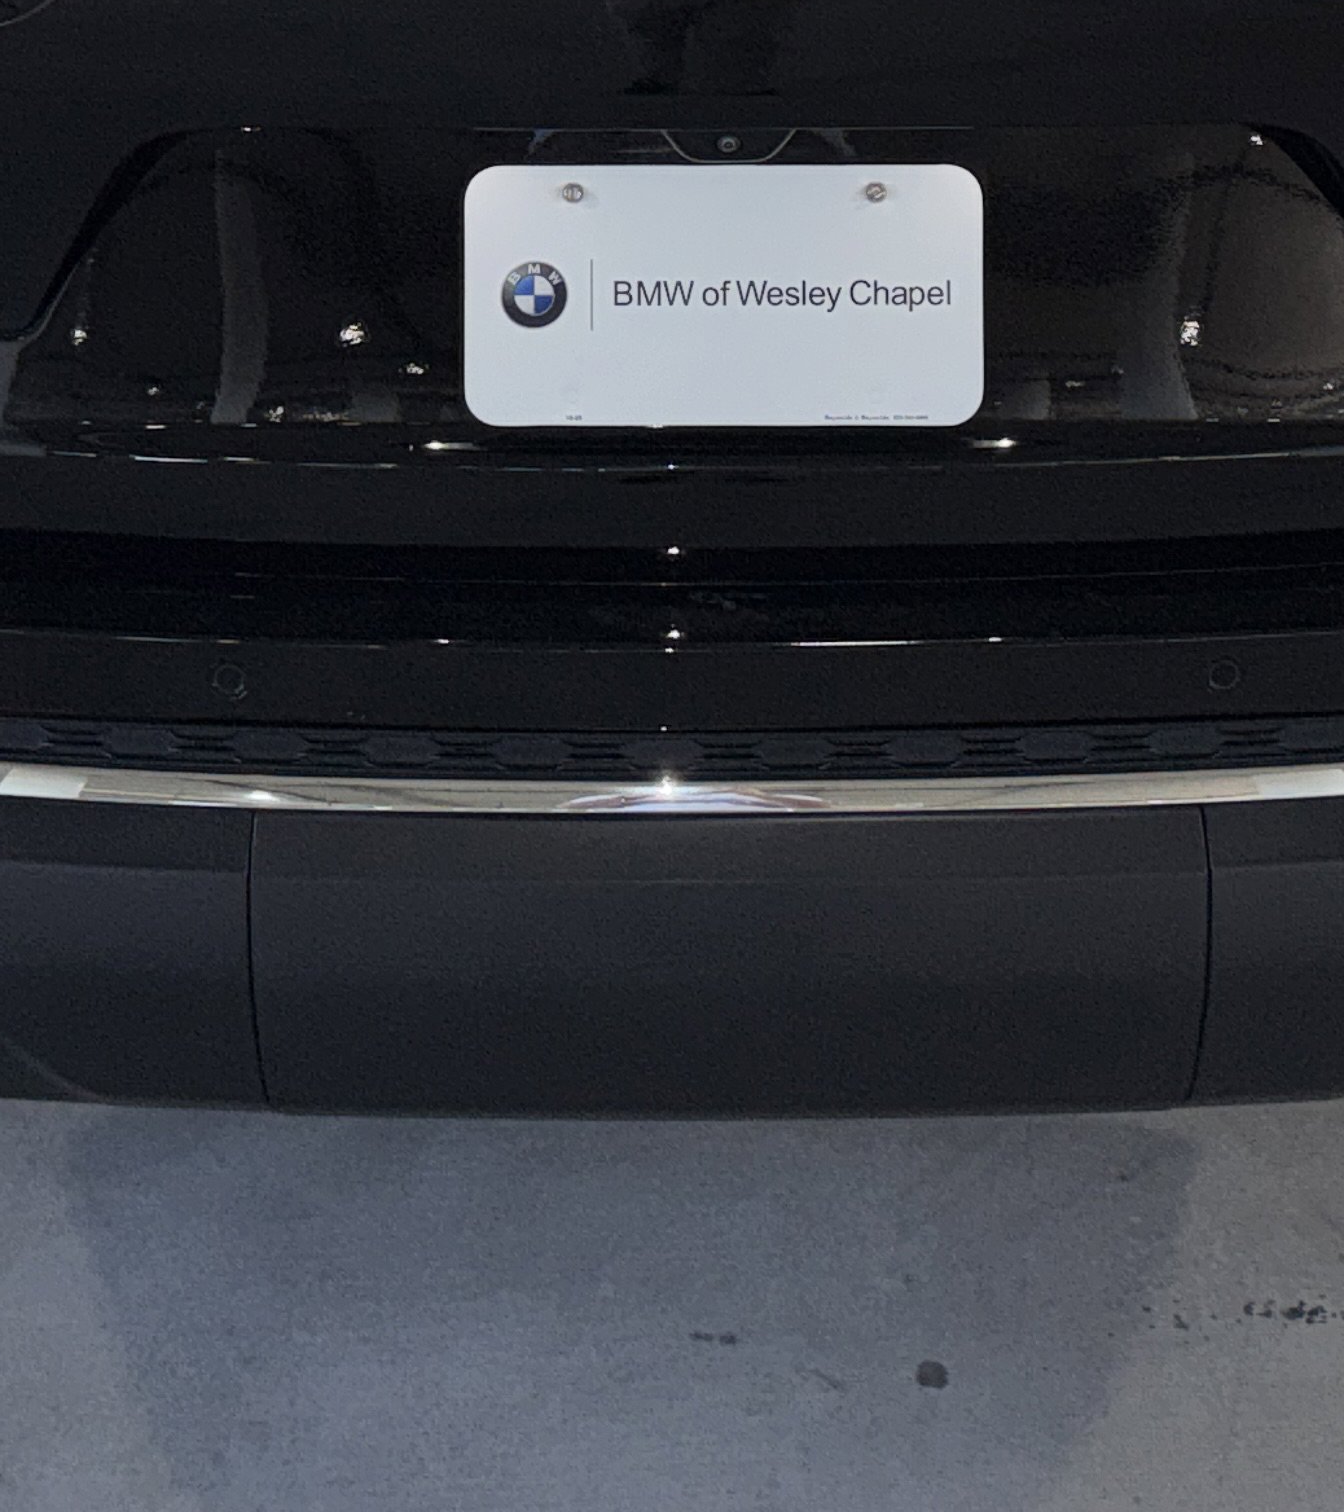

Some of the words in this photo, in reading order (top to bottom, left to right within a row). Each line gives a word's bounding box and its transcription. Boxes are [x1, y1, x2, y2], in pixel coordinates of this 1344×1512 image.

[507, 263, 563, 286] BMW
[613, 280, 694, 307] BMW
[702, 280, 732, 307] of
[736, 280, 843, 313] Wesley
[849, 279, 952, 313] Chapel
